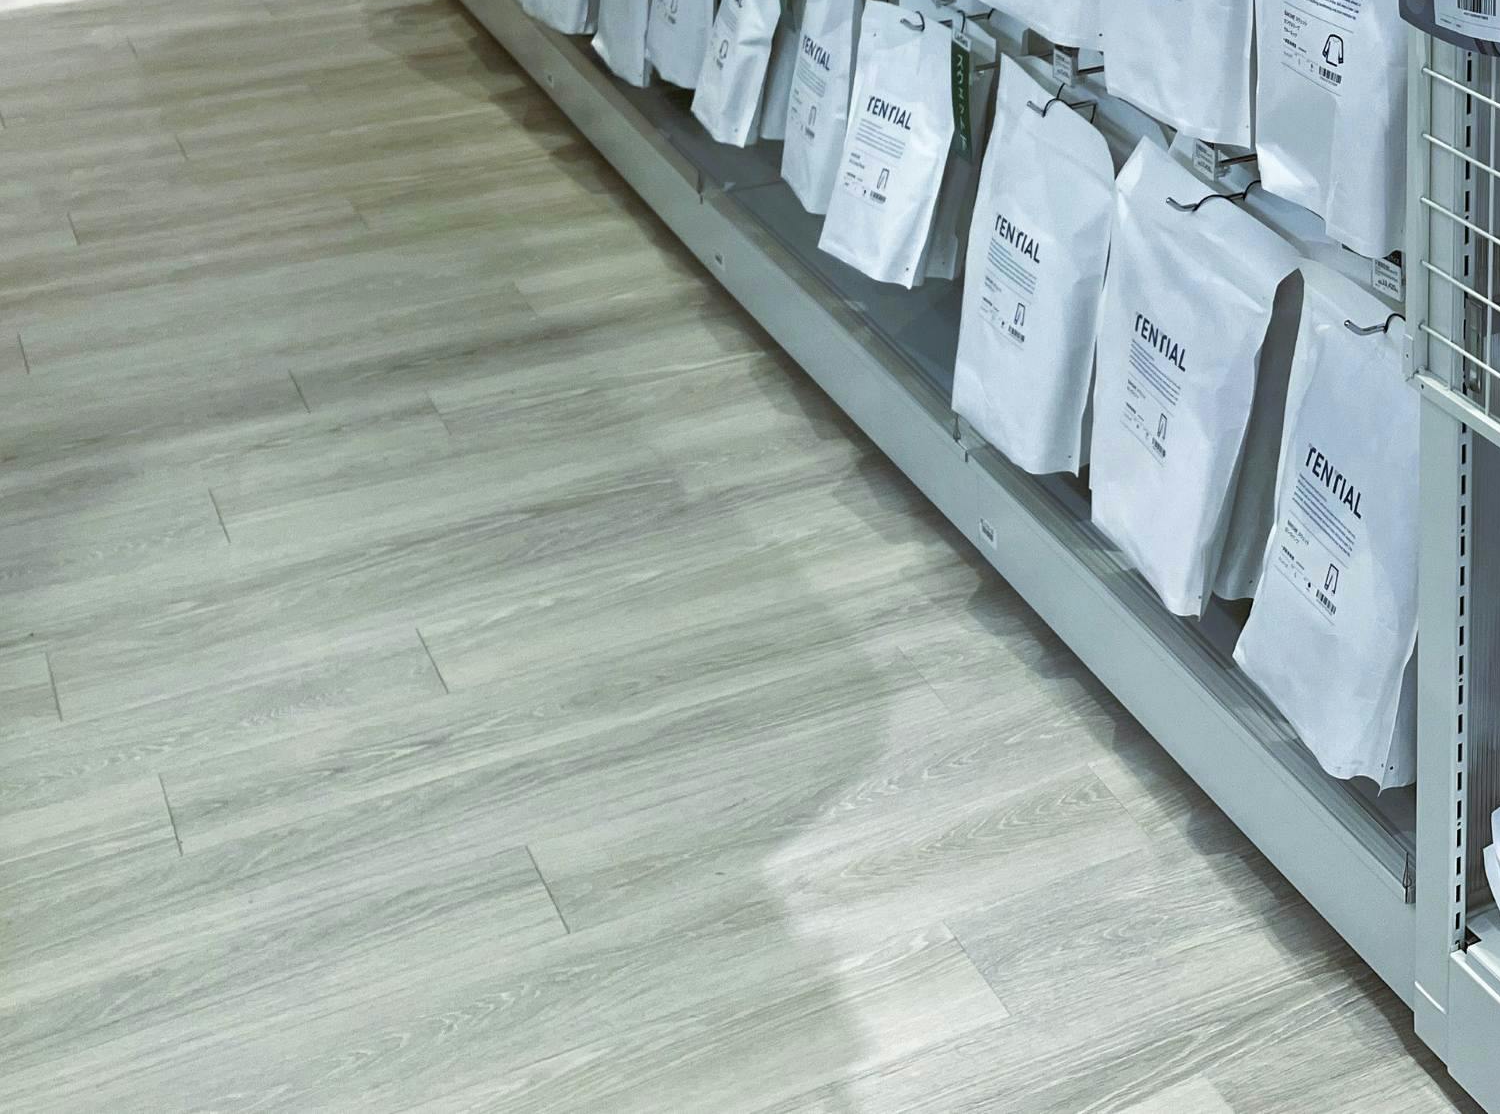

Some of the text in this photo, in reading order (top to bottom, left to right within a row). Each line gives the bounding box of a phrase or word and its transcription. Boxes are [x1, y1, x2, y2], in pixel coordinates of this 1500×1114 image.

[803, 35, 830, 71] TENTIAL
[866, 95, 912, 131] TENTIAL
[994, 213, 1041, 265] TENTIAL
[1134, 311, 1187, 373] TENTIAL
[1305, 443, 1361, 520] TENTIAL
